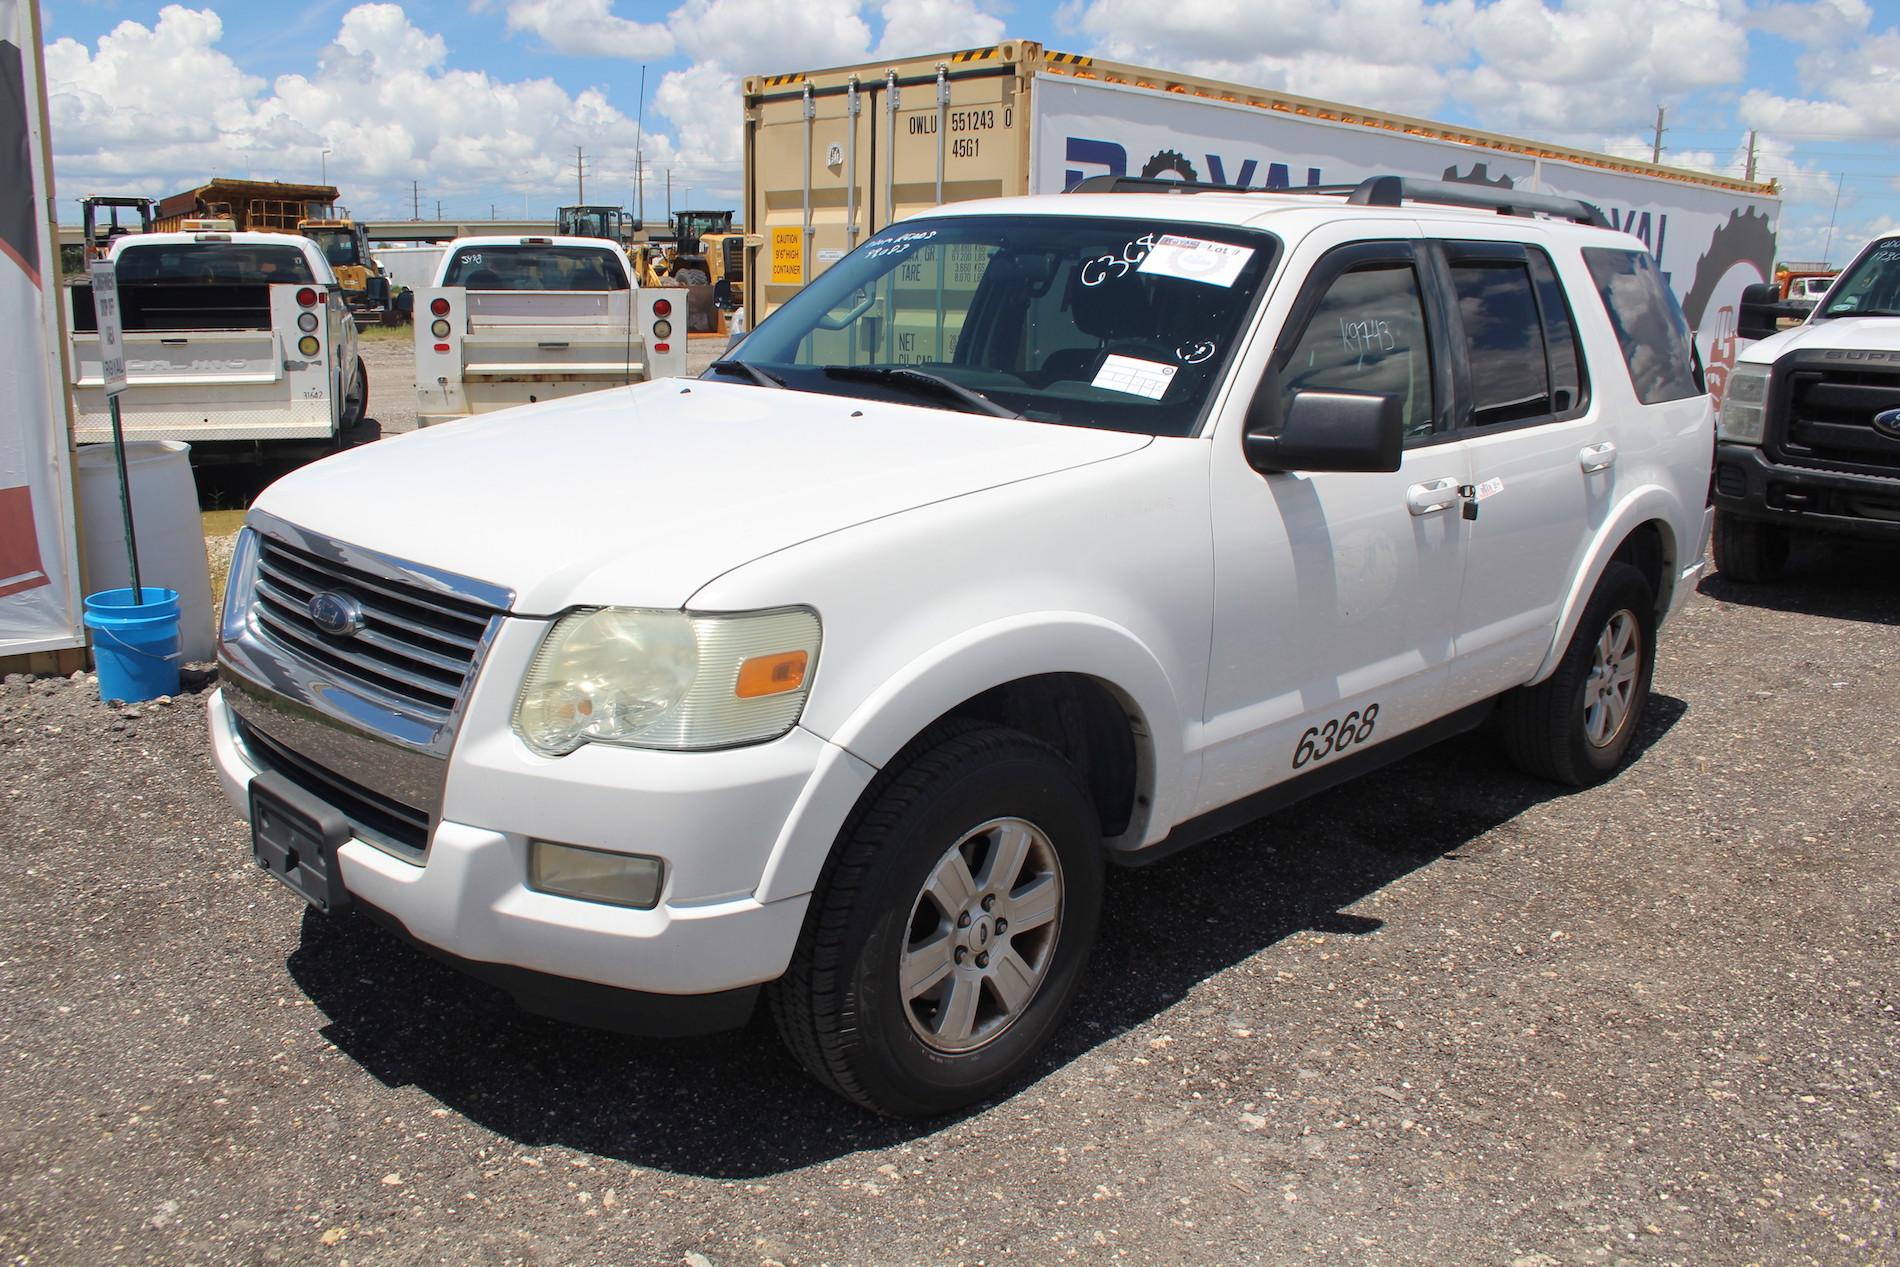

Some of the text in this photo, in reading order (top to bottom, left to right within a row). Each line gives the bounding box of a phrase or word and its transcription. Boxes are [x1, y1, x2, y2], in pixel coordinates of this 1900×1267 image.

[908, 115, 938, 135] OWLU
[951, 110, 994, 132] 551243
[952, 138, 979, 158] 45G1
[776, 234, 798, 244] CAUTION
[773, 265, 801, 274] CONTAINER
[901, 264, 921, 281] TARE
[899, 333, 915, 352] NET
[1292, 703, 1380, 769] 6368
